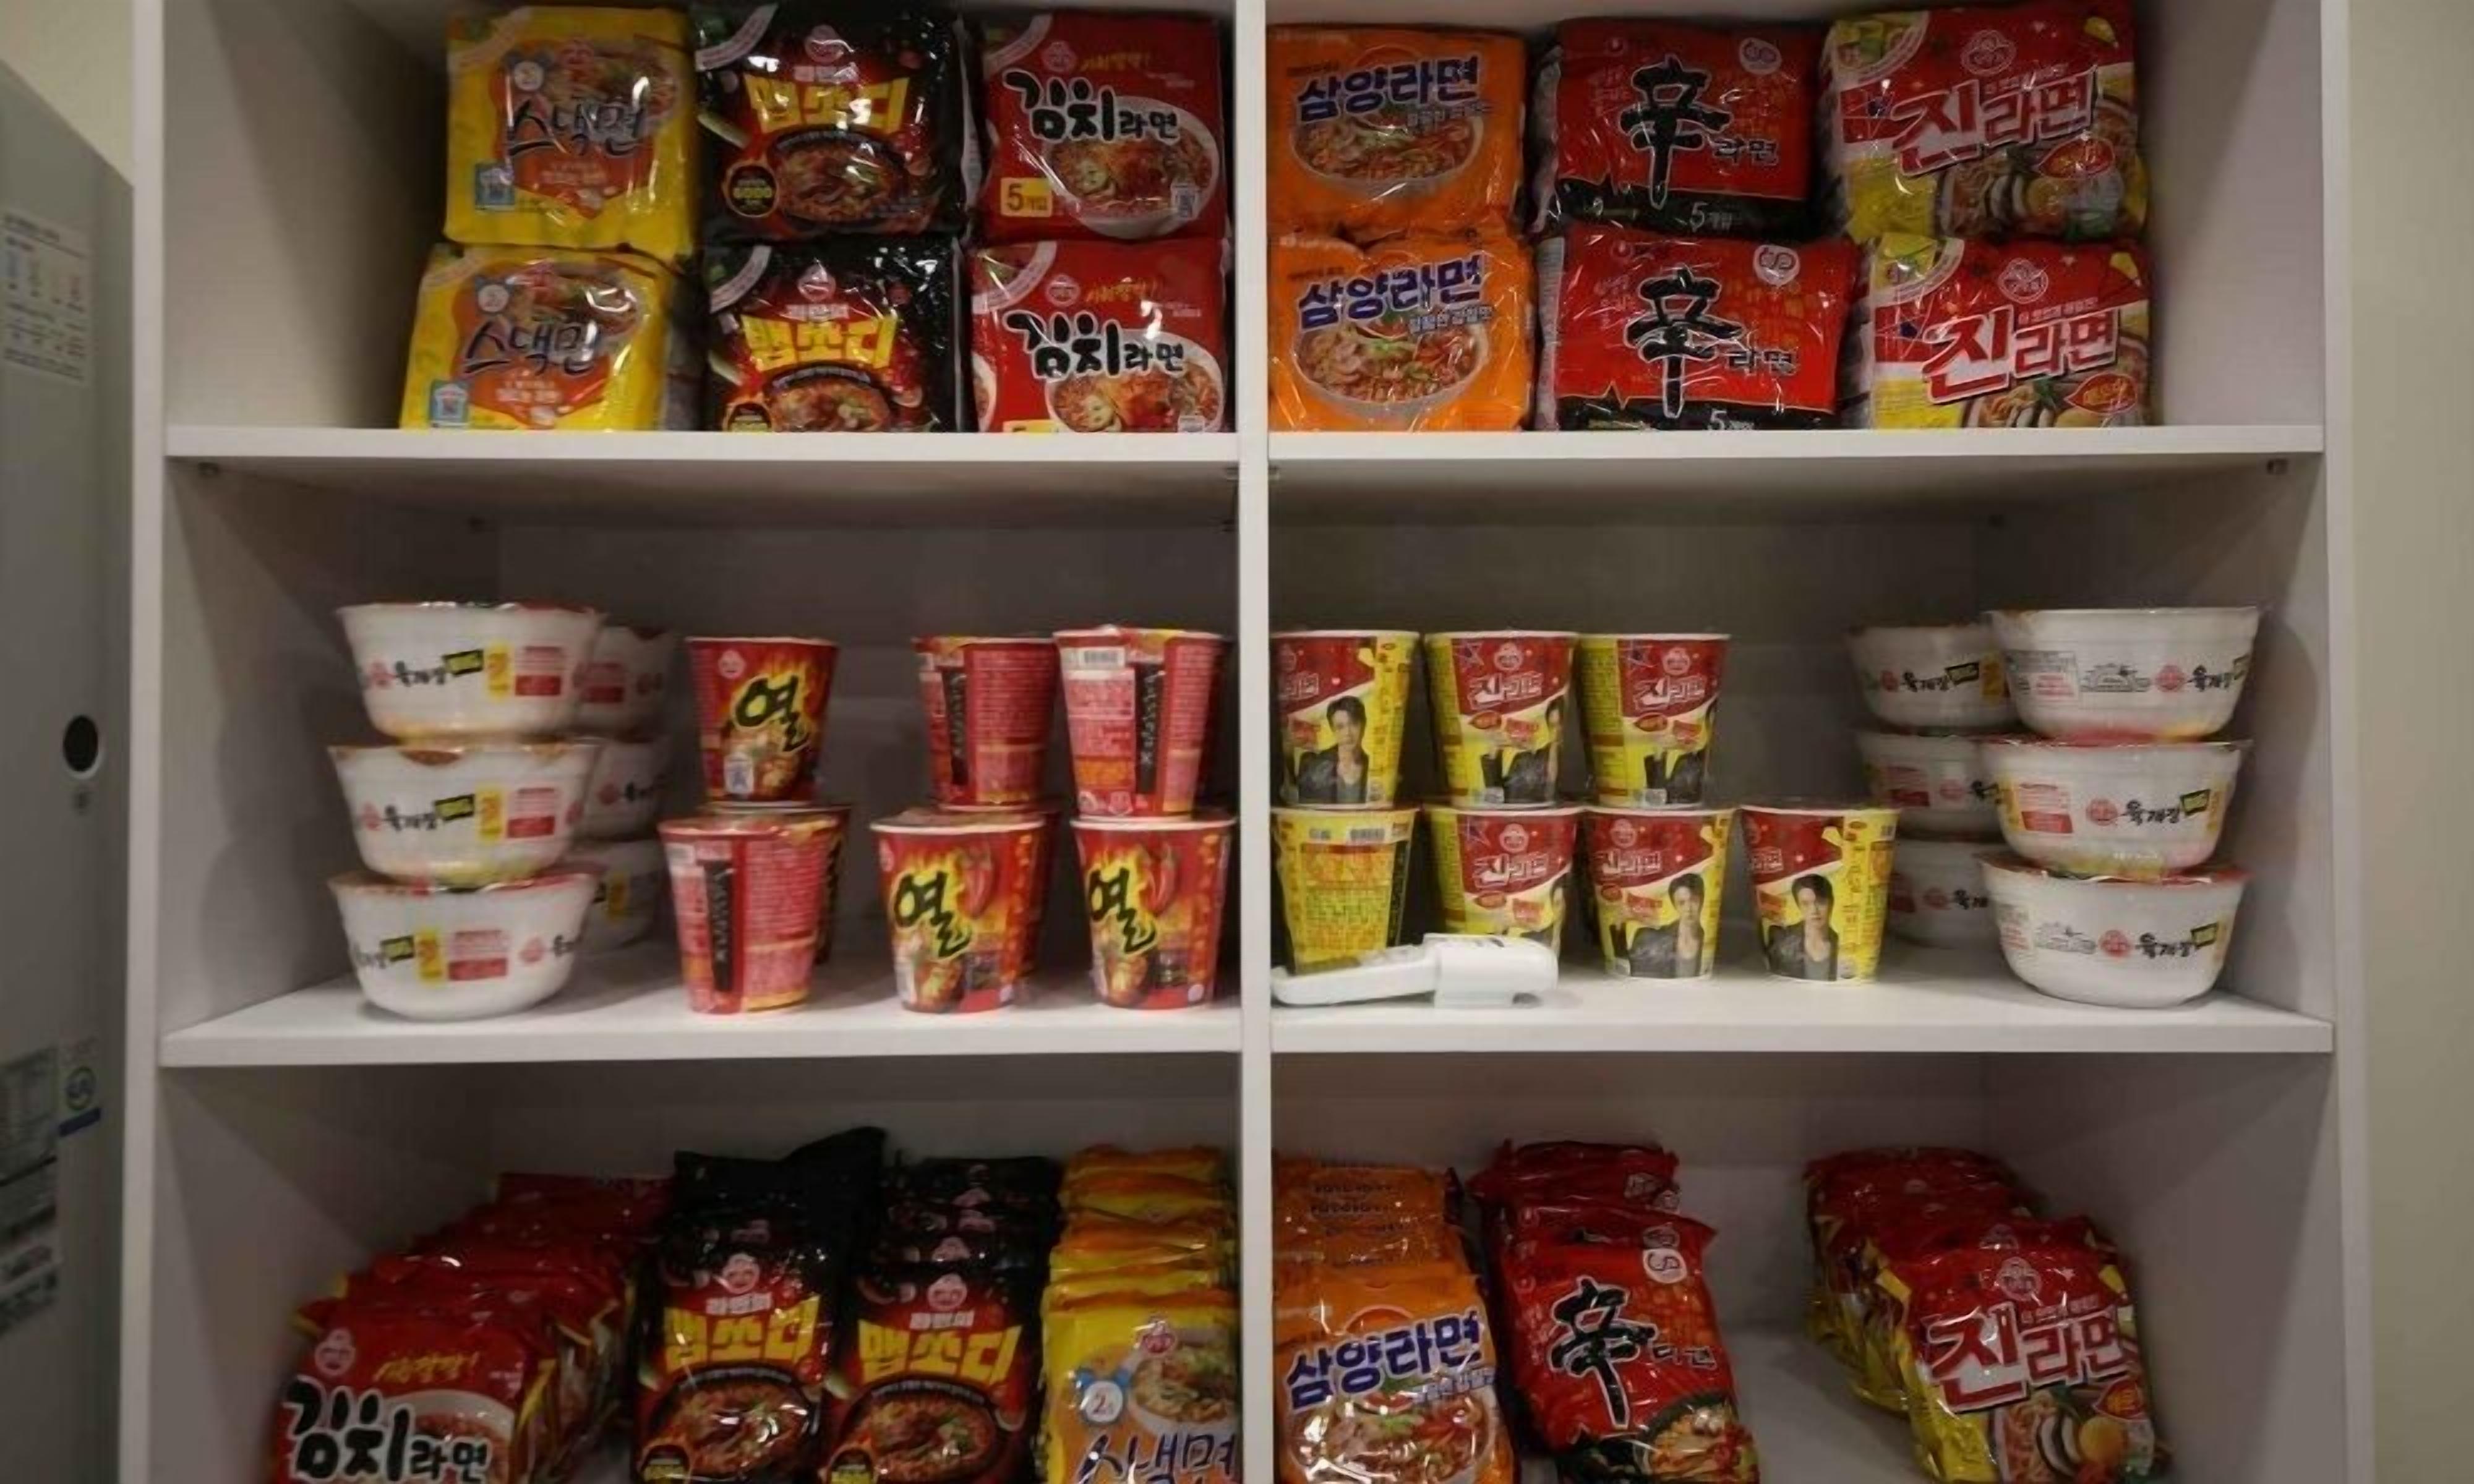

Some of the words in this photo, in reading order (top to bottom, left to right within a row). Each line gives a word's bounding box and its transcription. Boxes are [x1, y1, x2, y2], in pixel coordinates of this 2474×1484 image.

[1003, 69, 1179, 143] 김치라면
[1297, 56, 1479, 122] 삼양라면
[1891, 69, 2094, 176] 진라면
[1298, 254, 1483, 330] 삼양라면
[1004, 310, 1184, 378] 김치라면
[1922, 305, 2120, 403] 진라면
[1287, 1310, 1480, 1409] 삼양라면
[1927, 1302, 2131, 1412] 진라면
[286, 1379, 489, 1482] 김치라면
